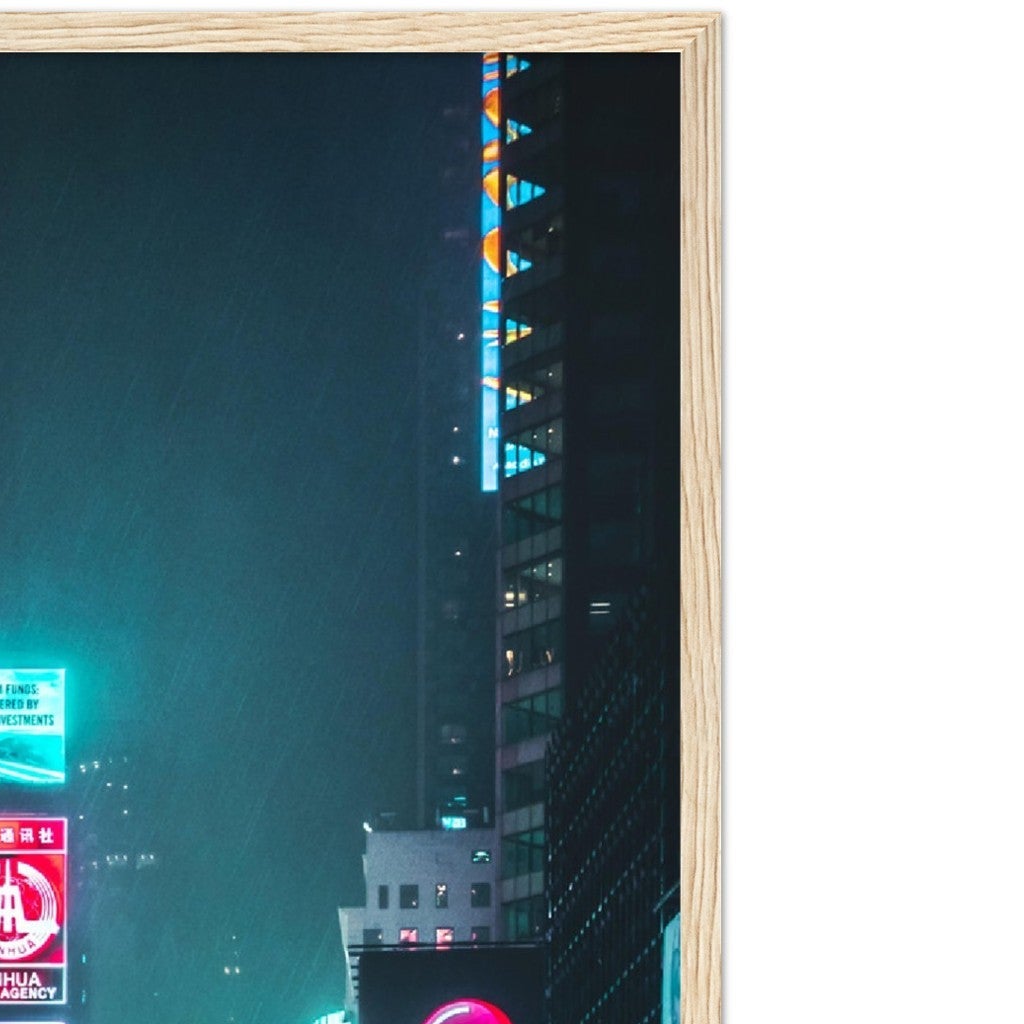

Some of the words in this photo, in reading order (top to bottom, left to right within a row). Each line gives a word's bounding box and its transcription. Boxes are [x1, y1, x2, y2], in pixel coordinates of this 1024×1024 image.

[5, 683, 40, 695] FUNDS:
[27, 699, 39, 710] BY
[0, 987, 57, 999] AGENCY
